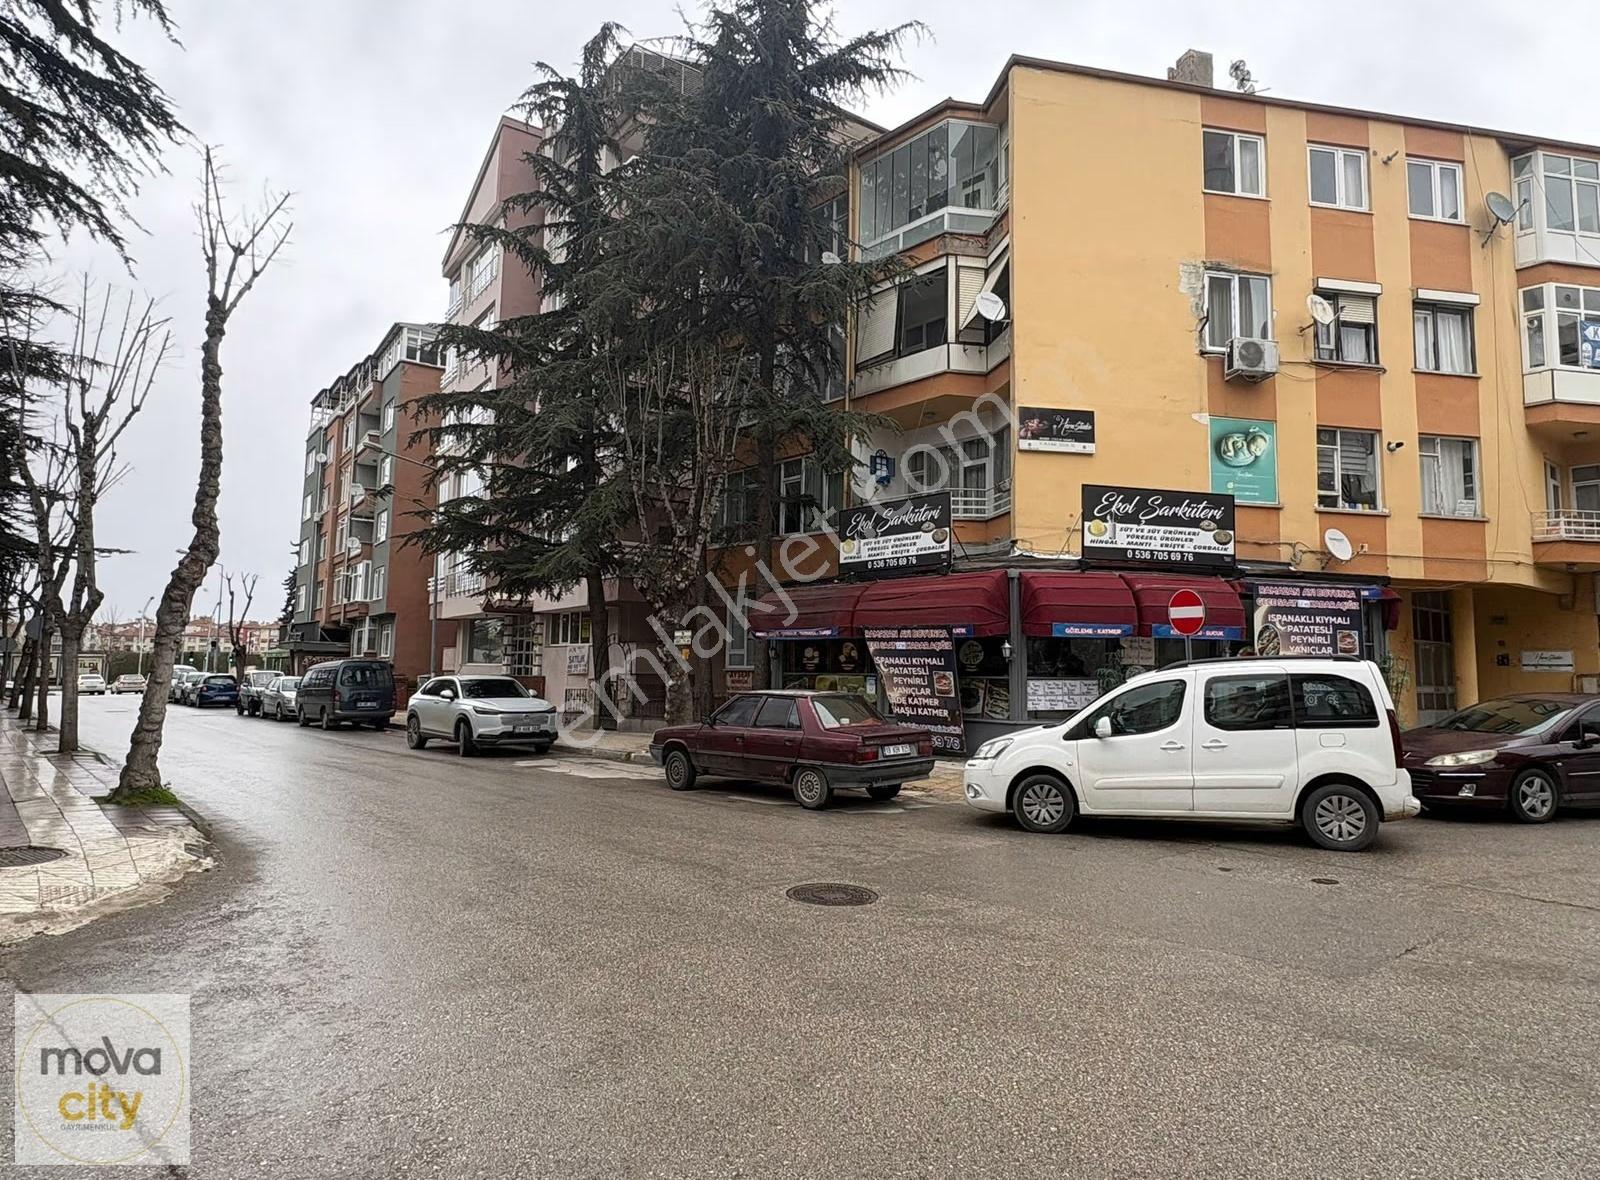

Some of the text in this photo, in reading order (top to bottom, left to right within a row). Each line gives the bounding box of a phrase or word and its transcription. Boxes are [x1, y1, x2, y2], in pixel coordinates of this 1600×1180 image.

[1093, 491, 1225, 526] Ekol Şarküteri
[846, 503, 942, 537] Ekol Şarküteri
[1125, 533, 1194, 543] YÖRESEL ÜRÜNLER
[1127, 550, 1194, 562] 0 536 705 69 76
[873, 560, 885, 568] 536
[886, 559, 897, 567] 705
[899, 557, 907, 565] 69
[908, 556, 917, 565] 76
[1268, 614, 1350, 625] ISPANAKLI KIYMALI
[1065, 627, 1094, 635] GÖZLEME
[1287, 625, 1333, 634] PATATESLİ
[1291, 634, 1331, 644] PEYNİRLİ
[1288, 645, 1334, 656] YANIÇLAR
[912, 657, 944, 666] KIYMALI
[889, 666, 929, 675] PATATESLİ
[893, 676, 928, 685] PEYNİRLİ
[908, 697, 939, 706] KATMER
[917, 707, 949, 718] KATMER
[944, 736, 960, 750] 76
